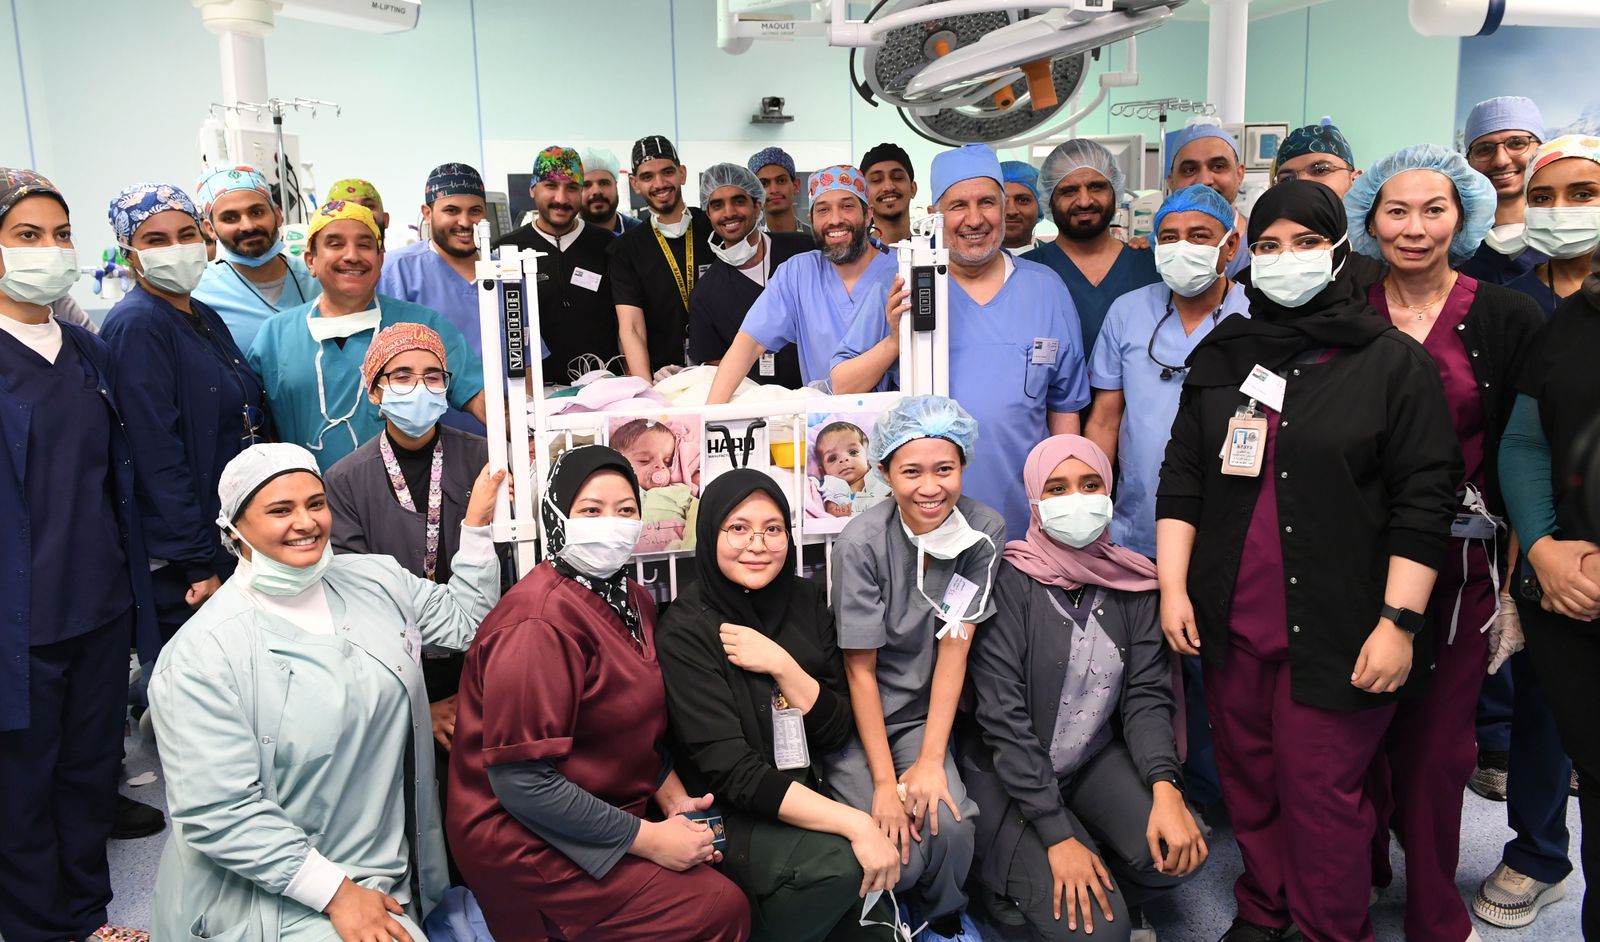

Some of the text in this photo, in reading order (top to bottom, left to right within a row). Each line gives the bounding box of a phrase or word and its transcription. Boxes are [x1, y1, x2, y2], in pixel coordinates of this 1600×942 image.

[372, 1, 406, 14] M-LIFTING
[761, 22, 795, 30] MAQUET
[707, 437, 755, 453] HARD
